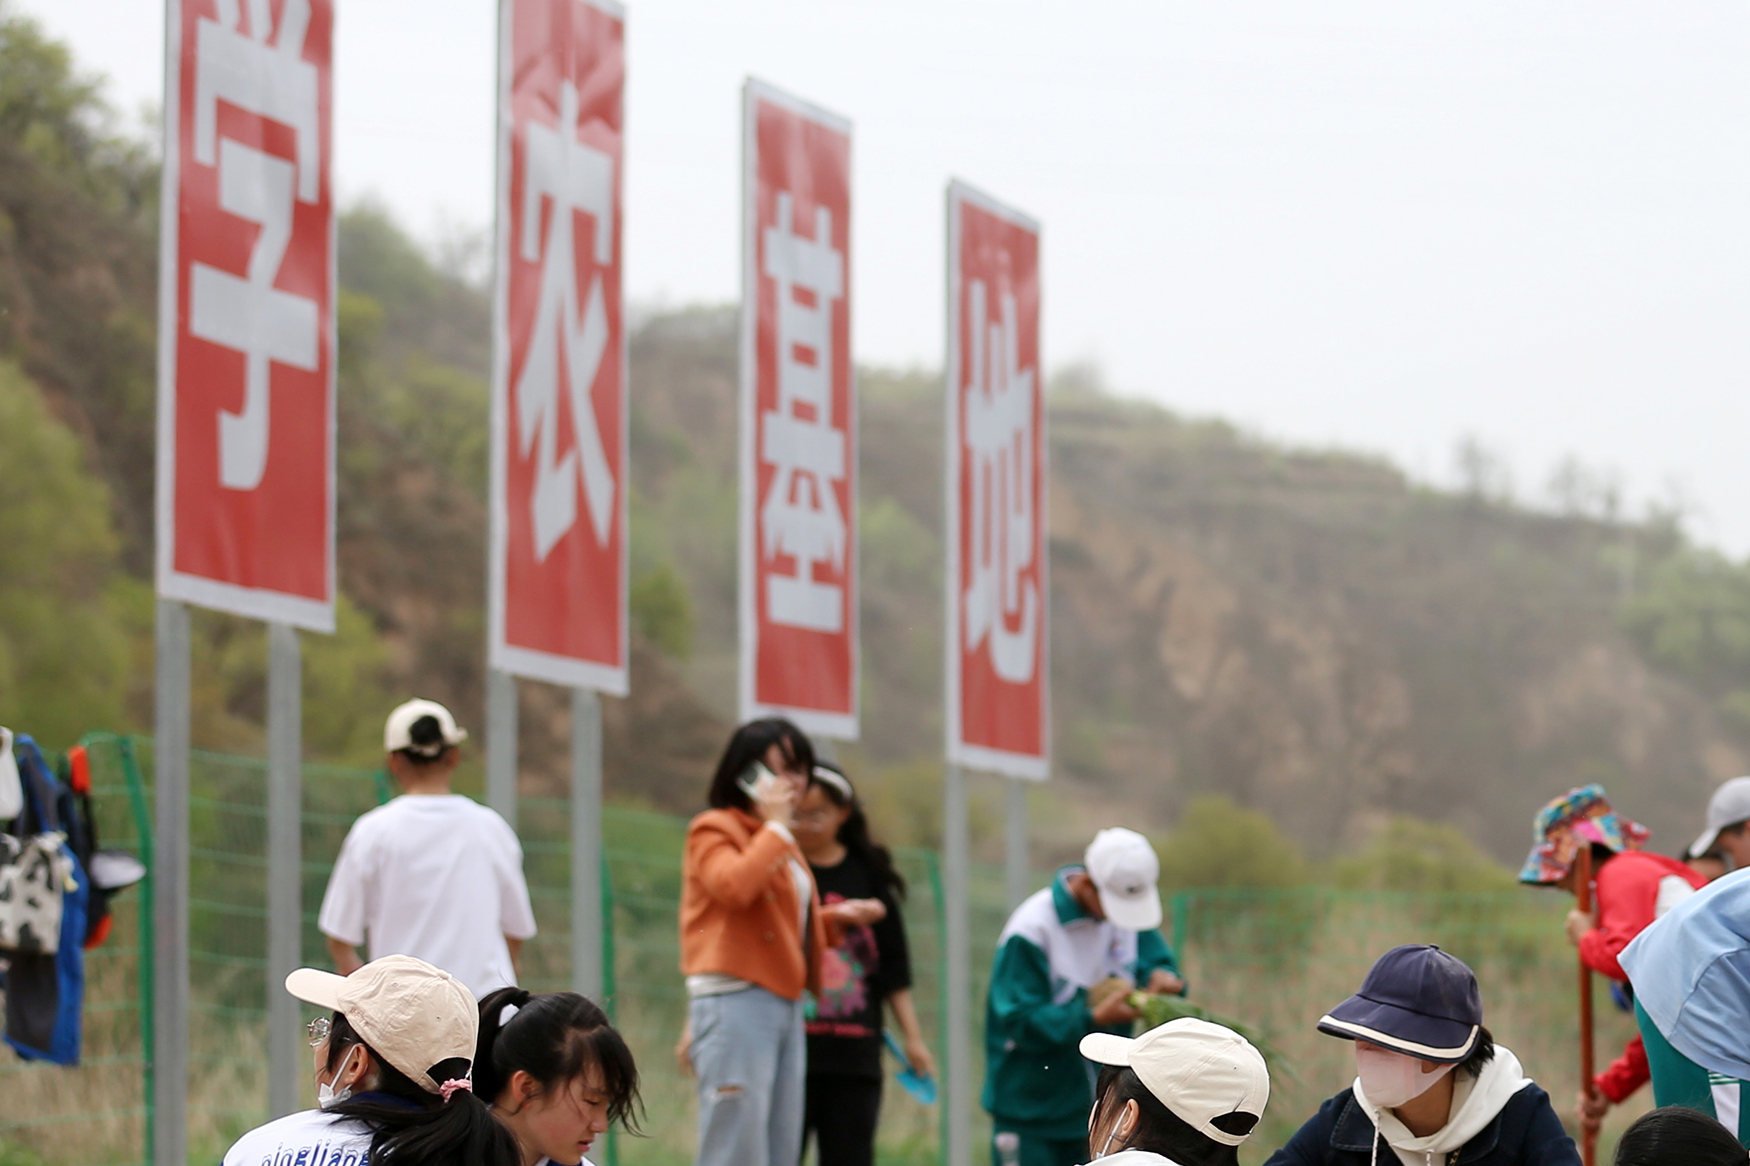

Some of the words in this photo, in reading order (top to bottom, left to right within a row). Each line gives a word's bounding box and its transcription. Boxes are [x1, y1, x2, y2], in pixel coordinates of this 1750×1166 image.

[191, 0, 318, 491] 学
[516, 80, 615, 563] 农
[761, 193, 846, 632] 基
[966, 279, 1036, 682] 地
